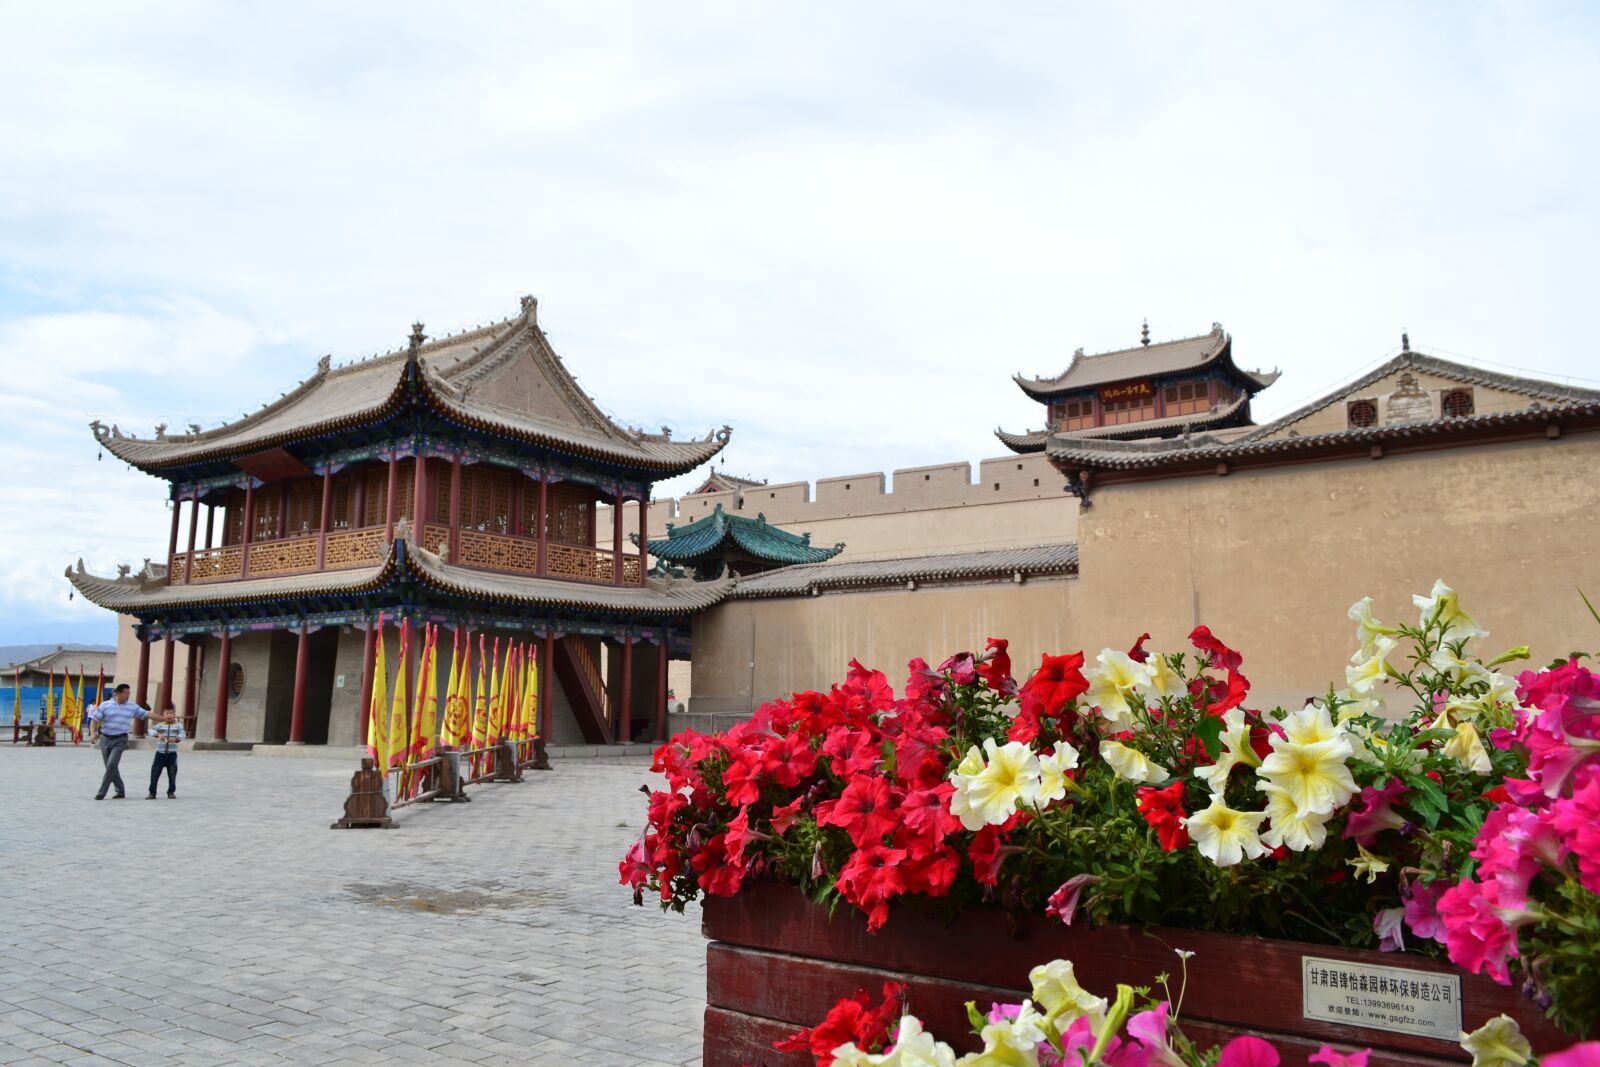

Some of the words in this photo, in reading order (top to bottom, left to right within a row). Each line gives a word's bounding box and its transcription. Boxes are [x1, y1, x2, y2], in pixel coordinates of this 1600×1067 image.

[1310, 967, 1452, 1003] 甘肃国锋怡森园林环保制造公司
